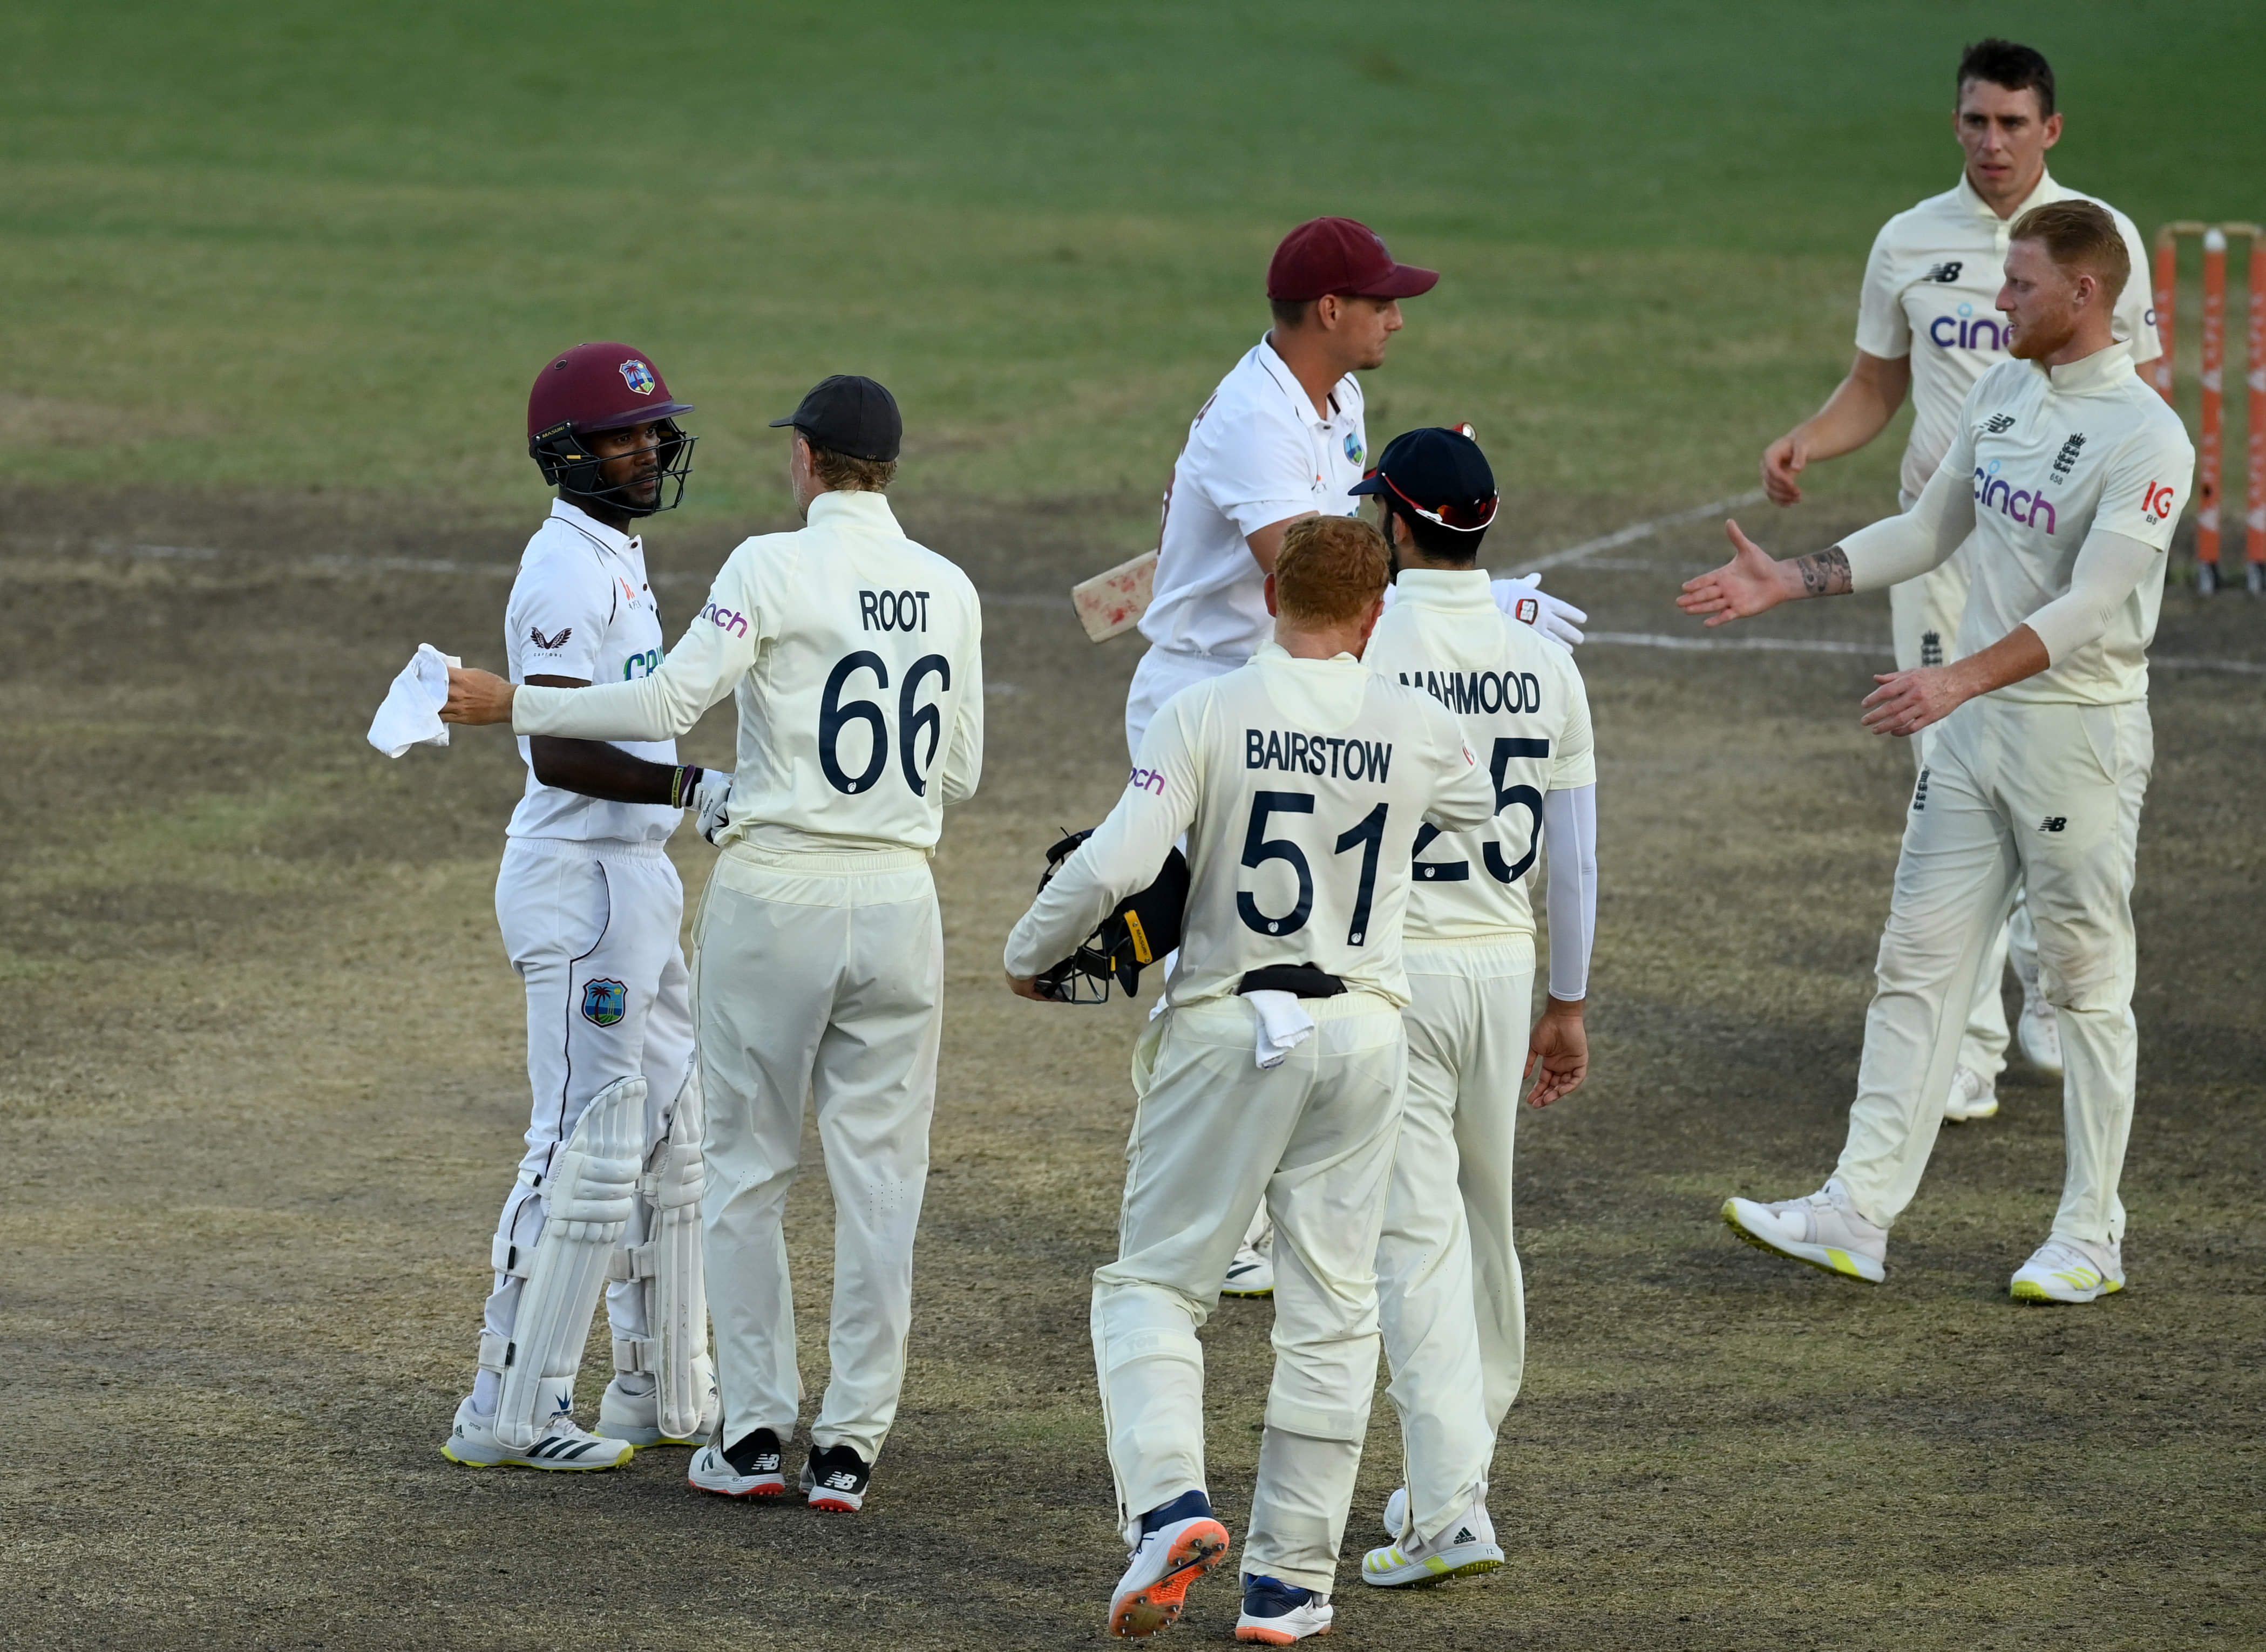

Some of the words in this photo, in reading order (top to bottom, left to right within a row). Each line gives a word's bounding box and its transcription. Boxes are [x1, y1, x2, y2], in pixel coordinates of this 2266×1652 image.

[542, 425, 565, 438] MASURI
[2050, 473, 2063, 485] 658
[2141, 480, 2174, 519] IG
[2146, 514, 2158, 525] BS
[859, 590, 930, 632] ROOT
[819, 650, 950, 797] 66
[1246, 729, 1392, 784] BAIRSTOW
[1237, 791, 1388, 947] 51
[1454, 1536, 1476, 1544] adidas
